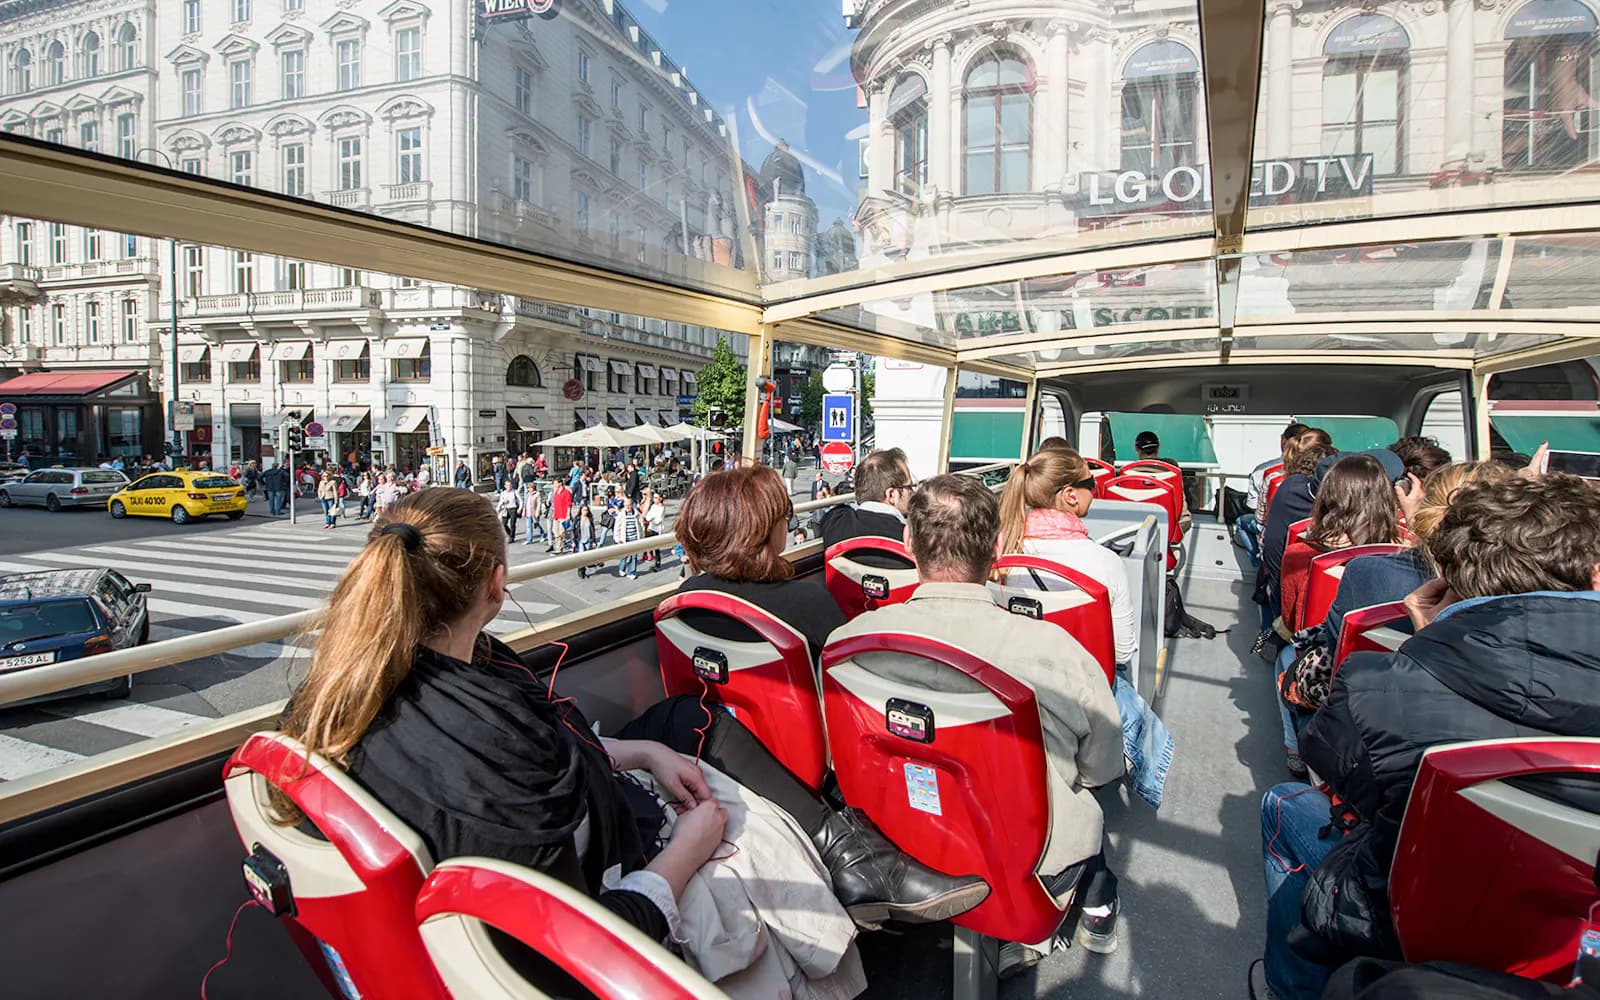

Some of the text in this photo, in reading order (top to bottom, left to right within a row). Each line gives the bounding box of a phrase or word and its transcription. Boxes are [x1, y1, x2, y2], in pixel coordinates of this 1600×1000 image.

[1089, 171, 1147, 205] LG
[1306, 156, 1373, 192] TV
[130, 496, 166, 505] TAXI 40100
[7, 655, 49, 667] 5253 AL
